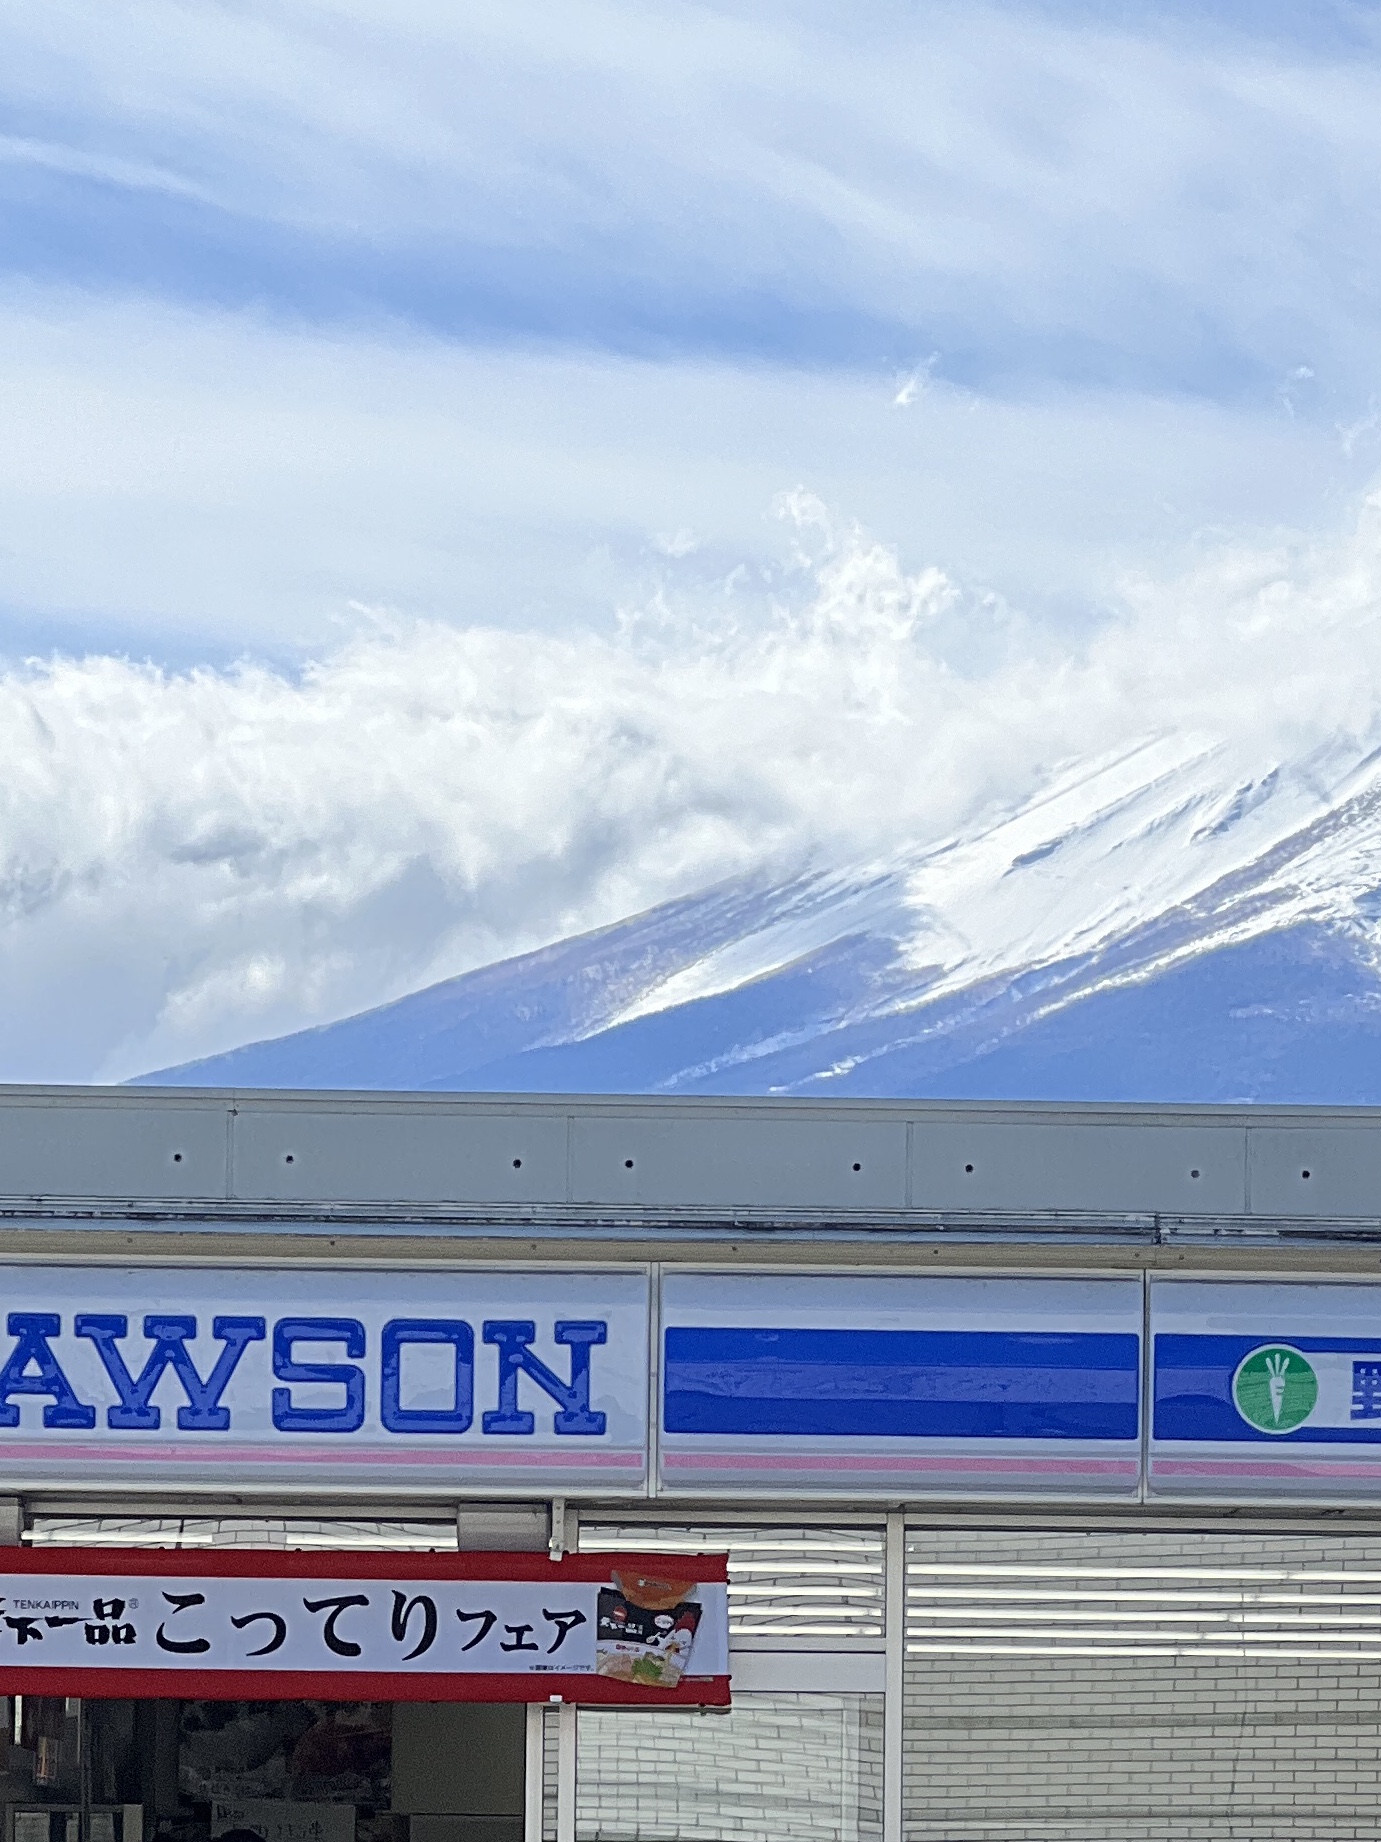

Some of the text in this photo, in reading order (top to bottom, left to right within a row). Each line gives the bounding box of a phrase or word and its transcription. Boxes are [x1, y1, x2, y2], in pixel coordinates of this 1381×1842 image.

[13, 1600, 79, 1610] TENKAIPPIN
[0, 1590, 588, 1661] 下一品 こってりフェア
